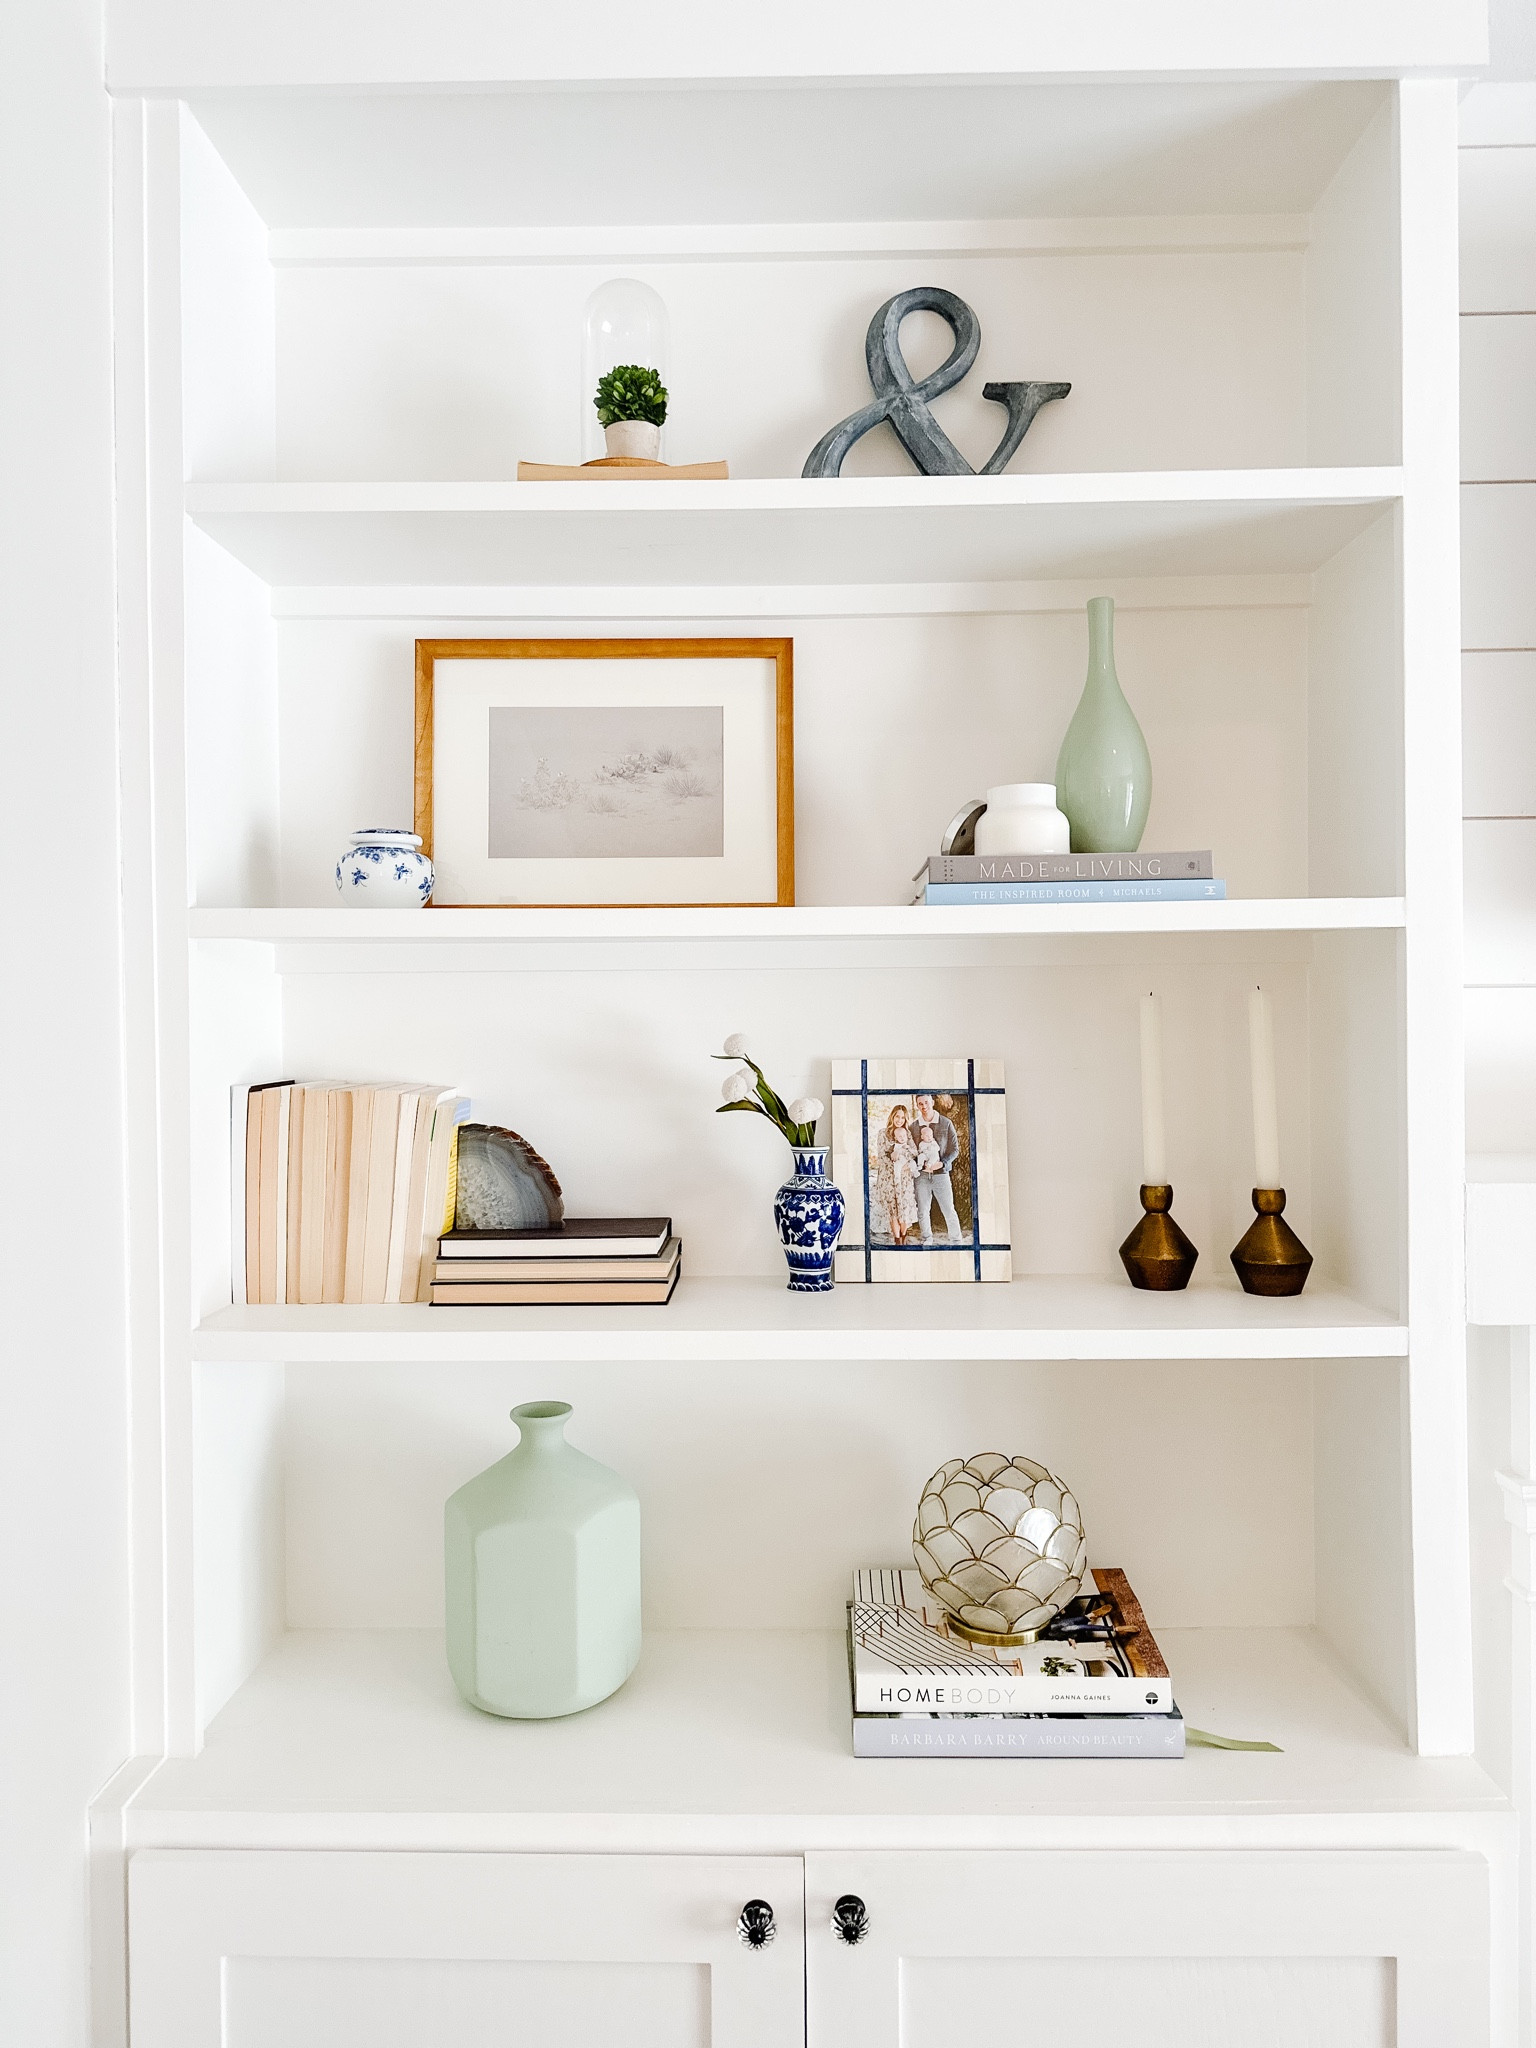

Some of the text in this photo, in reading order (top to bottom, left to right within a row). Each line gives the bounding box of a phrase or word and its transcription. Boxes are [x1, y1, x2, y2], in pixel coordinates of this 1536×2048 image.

[980, 861, 1049, 879] MADE
[1076, 859, 1161, 877] LIVING
[972, 887, 1162, 899] THE INSPIRED ROOM MICHAELS
[880, 1687, 1016, 1704] HOMEBODY
[890, 1733, 1143, 1746] BARBARA BARRY AROUND BEAUTY
